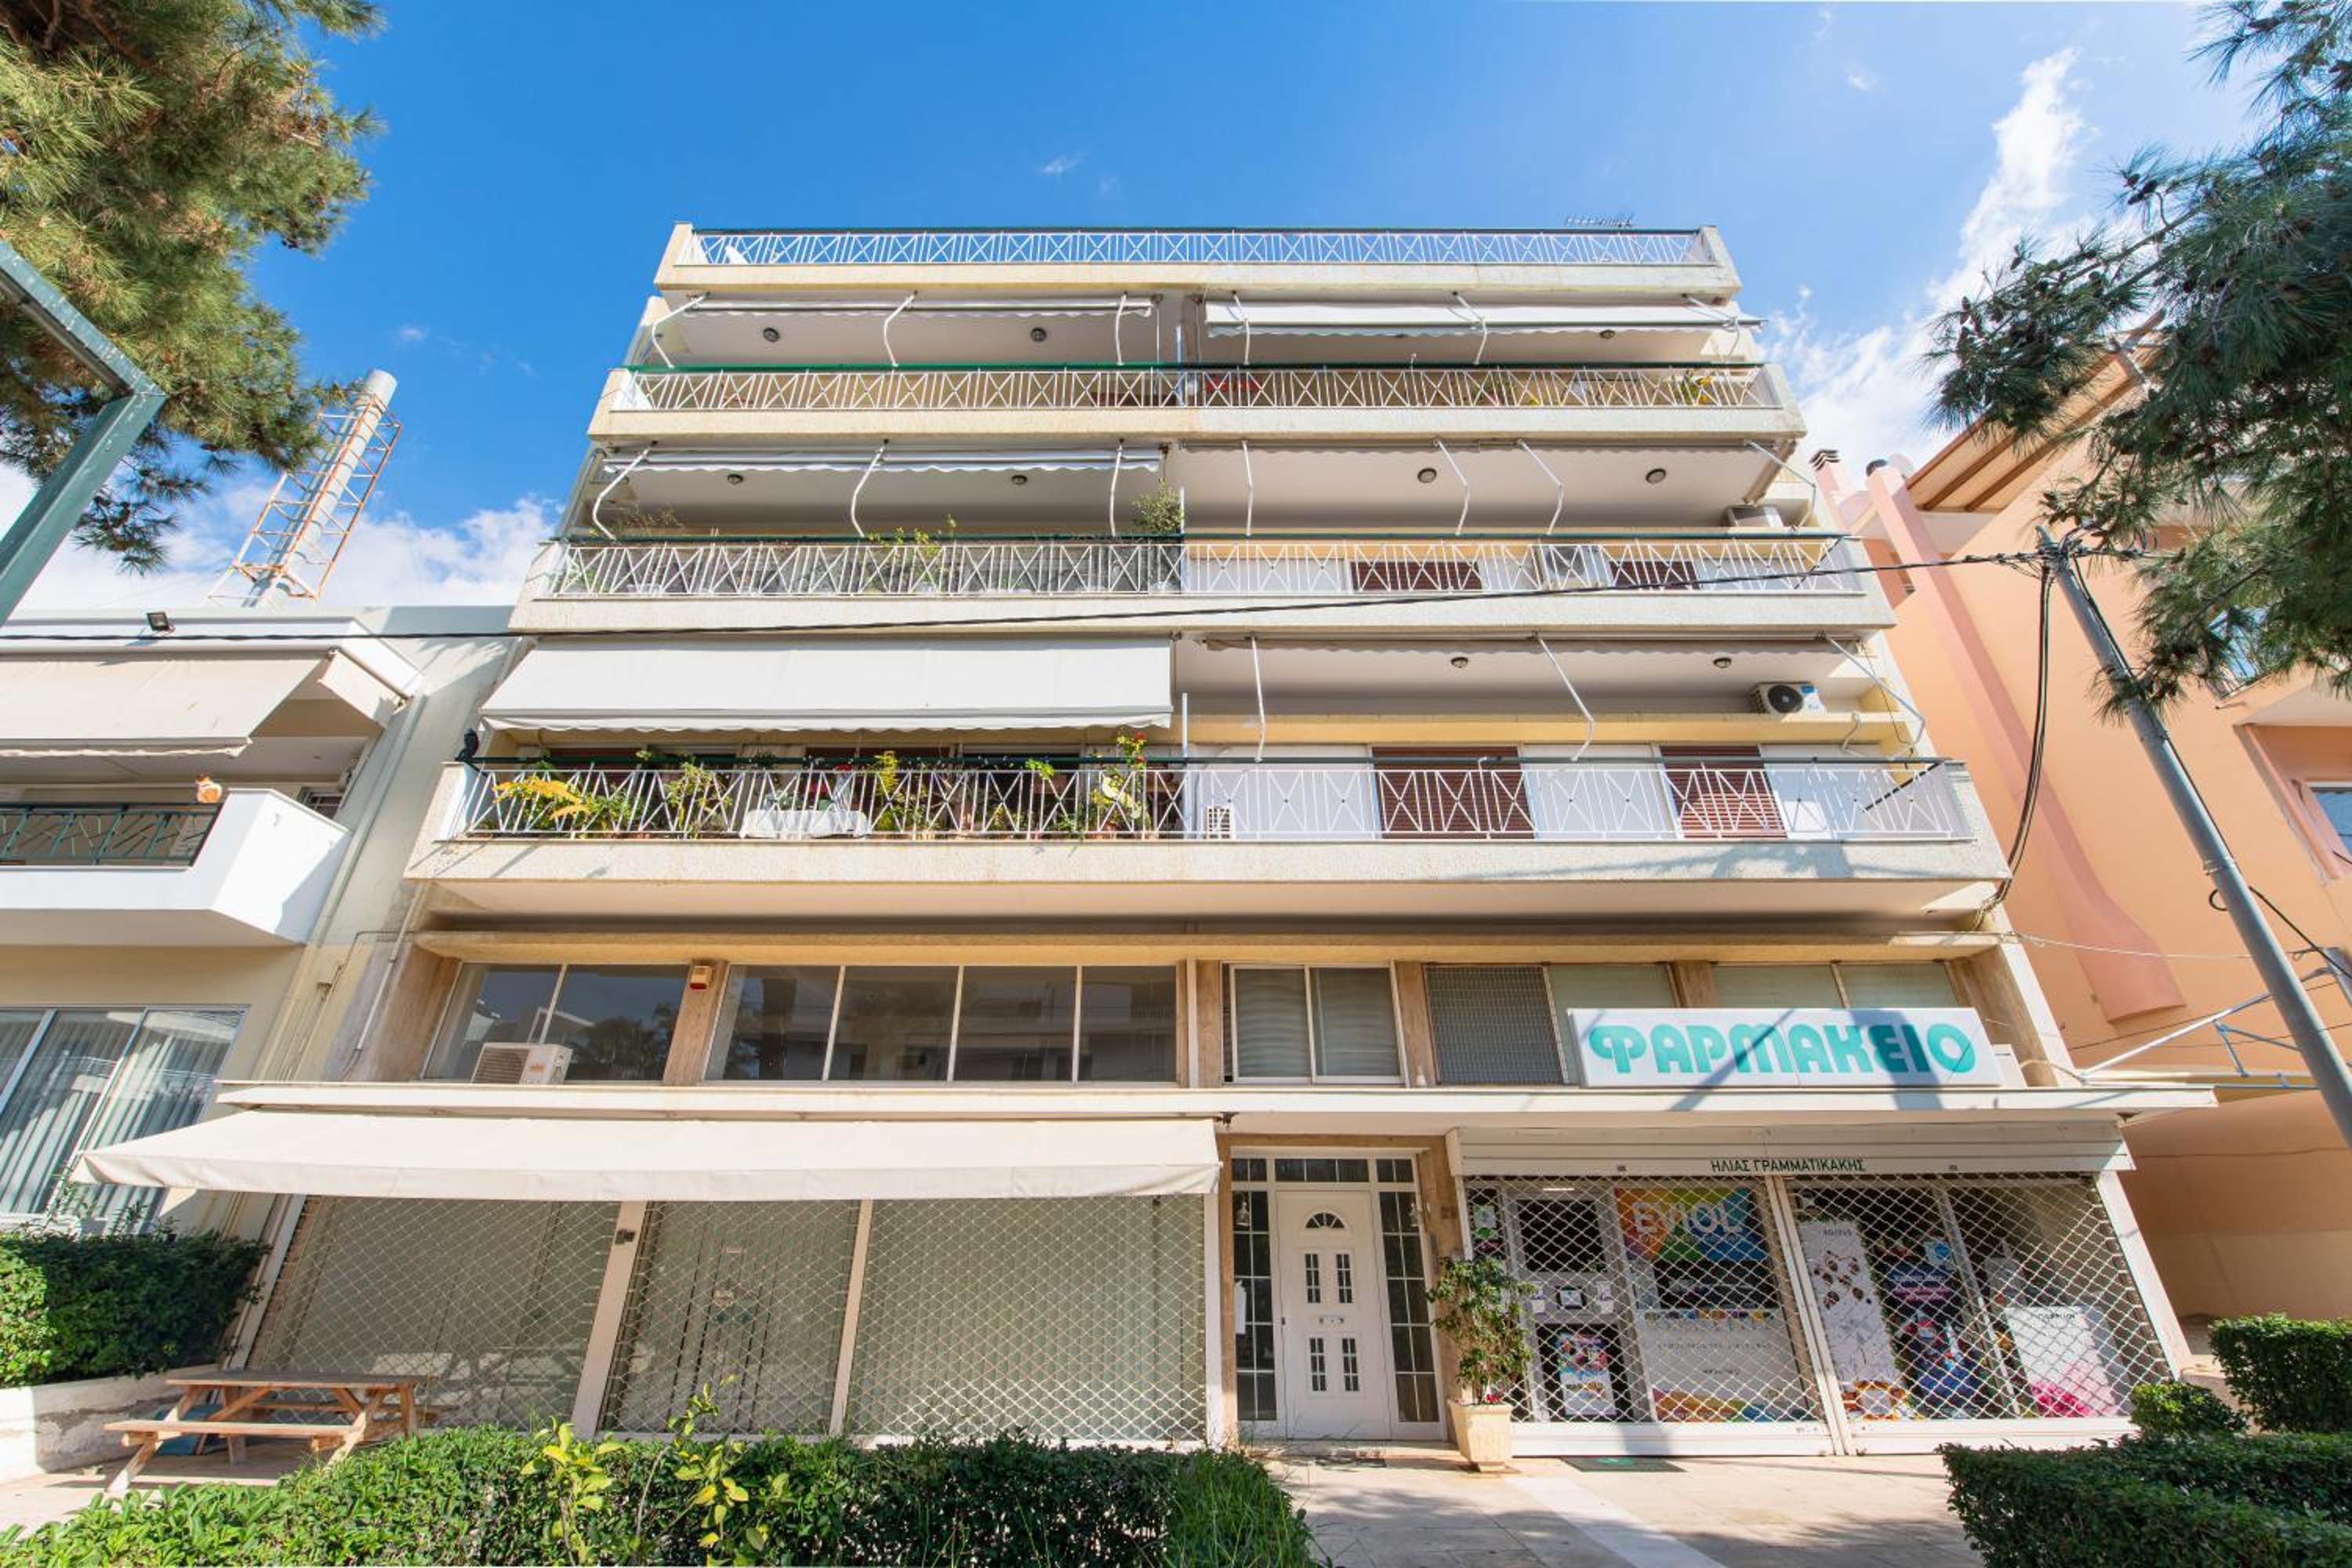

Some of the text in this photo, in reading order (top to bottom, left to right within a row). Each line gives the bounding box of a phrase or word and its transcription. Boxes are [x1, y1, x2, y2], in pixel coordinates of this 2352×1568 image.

[1588, 1023, 1976, 1073] ΦΑΡΜΑΚΕΙΟ
[1711, 1157, 1866, 1173] ΗΛΙΑΣ ΓΡΑΜΜΑΤΙΚΑΚΗΣ
